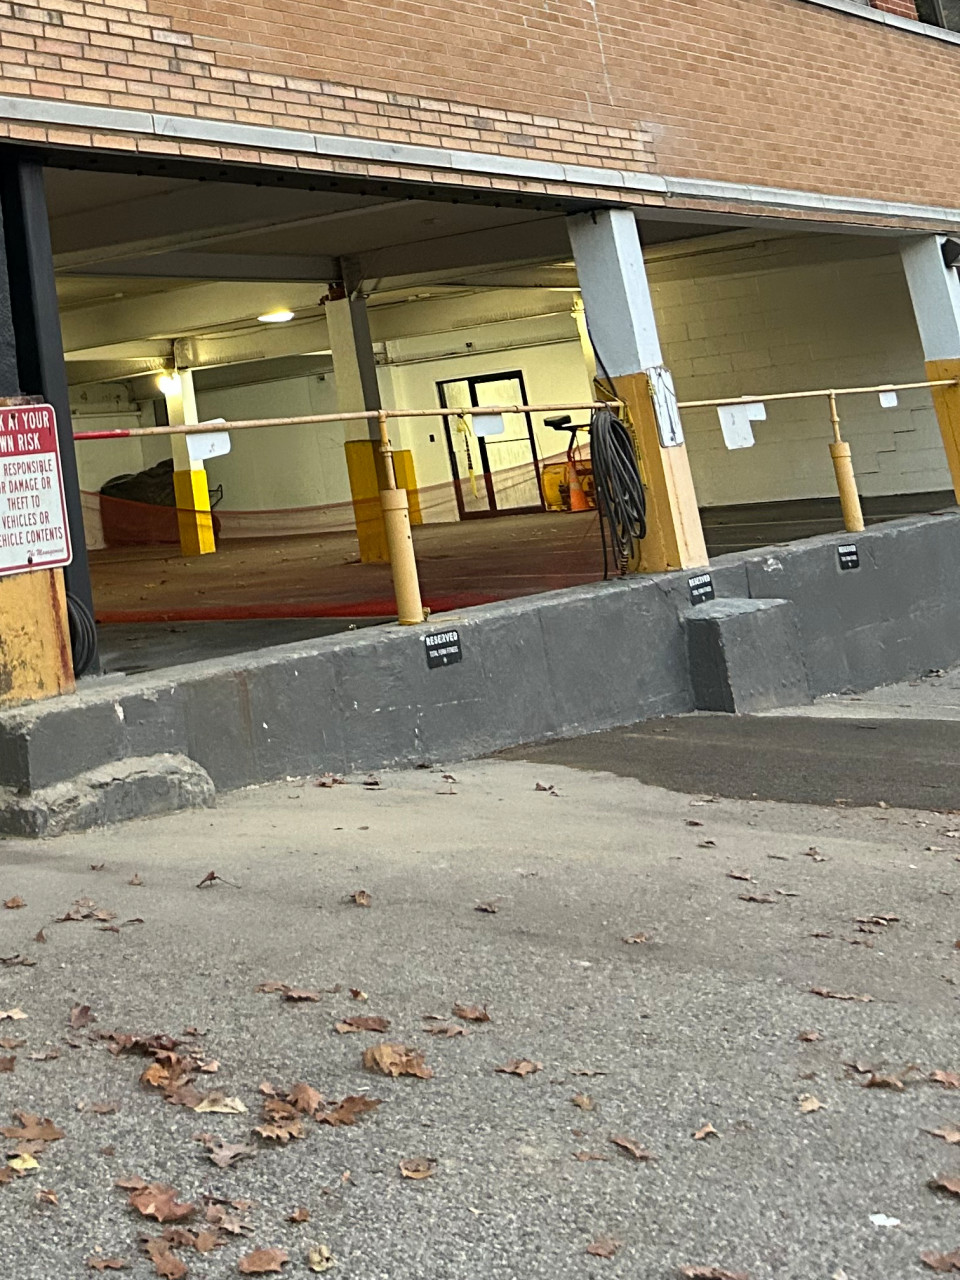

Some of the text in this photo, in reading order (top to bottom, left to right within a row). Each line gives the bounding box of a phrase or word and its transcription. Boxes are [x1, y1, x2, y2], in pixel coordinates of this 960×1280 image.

[8, 412, 19, 431] AT
[22, 411, 50, 430] YOUR
[17, 432, 41, 451] RISK
[3, 459, 53, 477] RESPONSIBLE
[9, 476, 40, 494] DAMAGE
[41, 476, 52, 490] OR
[7, 495, 41, 511] THEFT TO
[2, 511, 50, 530] VEHICLES OR
[25, 527, 63, 544] CONTENTS
[425, 631, 458, 646] RESERVED
